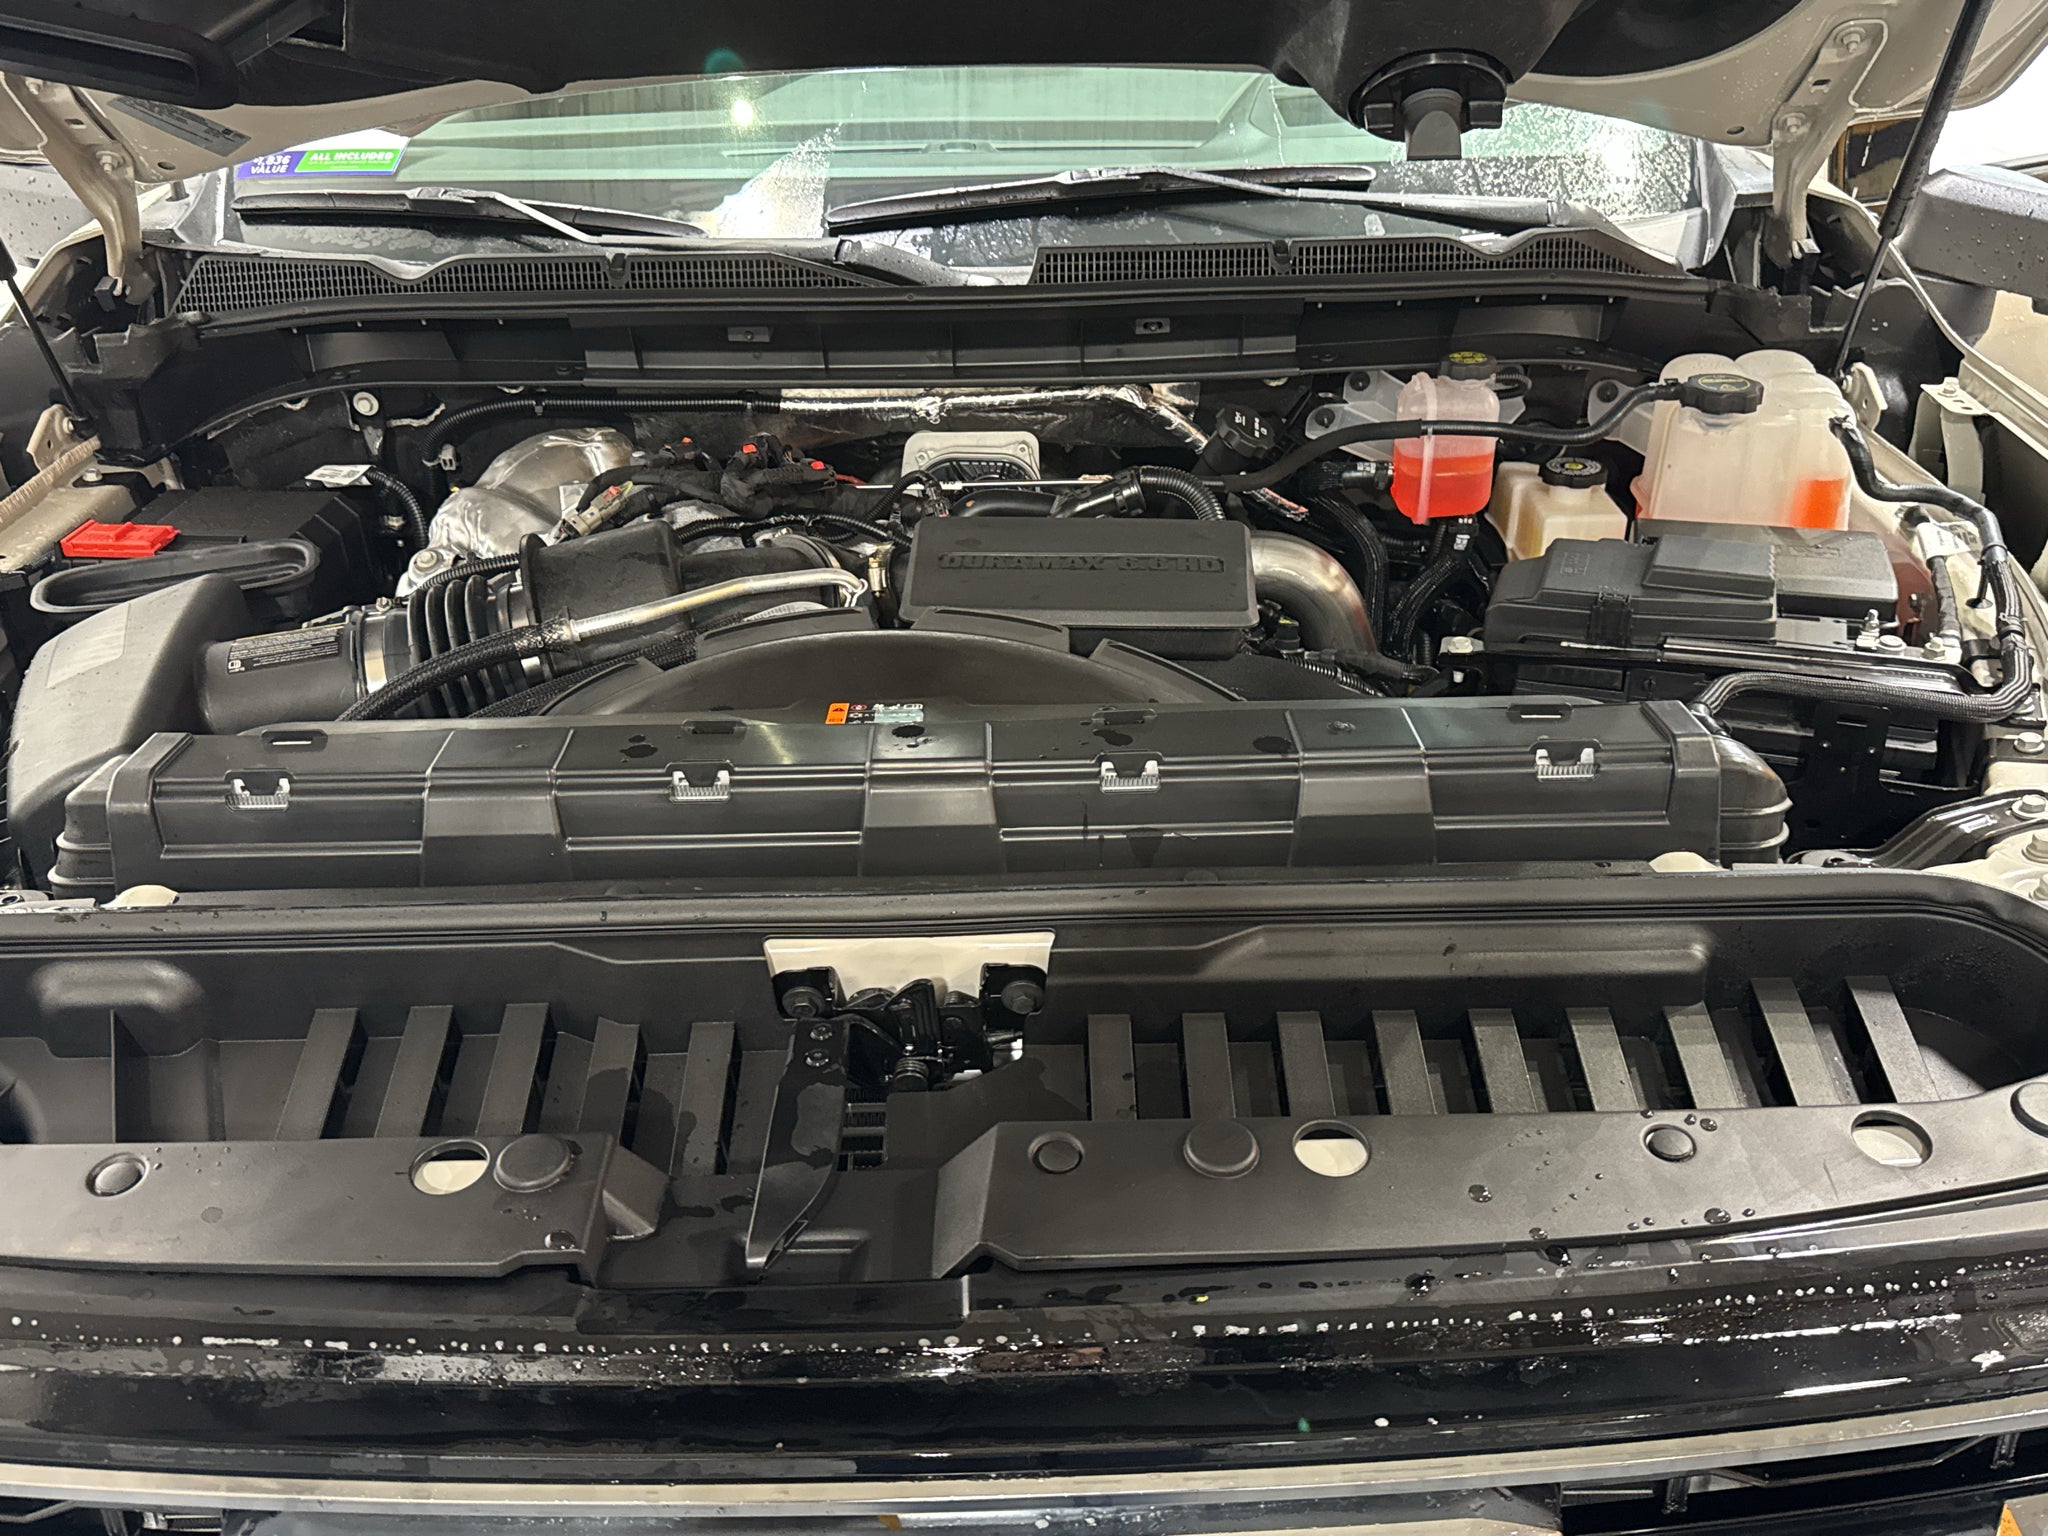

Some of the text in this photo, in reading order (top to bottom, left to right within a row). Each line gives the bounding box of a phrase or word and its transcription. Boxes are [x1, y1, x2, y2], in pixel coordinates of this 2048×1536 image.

[309, 151, 394, 161] ALL INCLUDED
[250, 165, 288, 174] VALUE
[938, 554, 1104, 570] DURAMAX
[1176, 557, 1224, 573] HD
